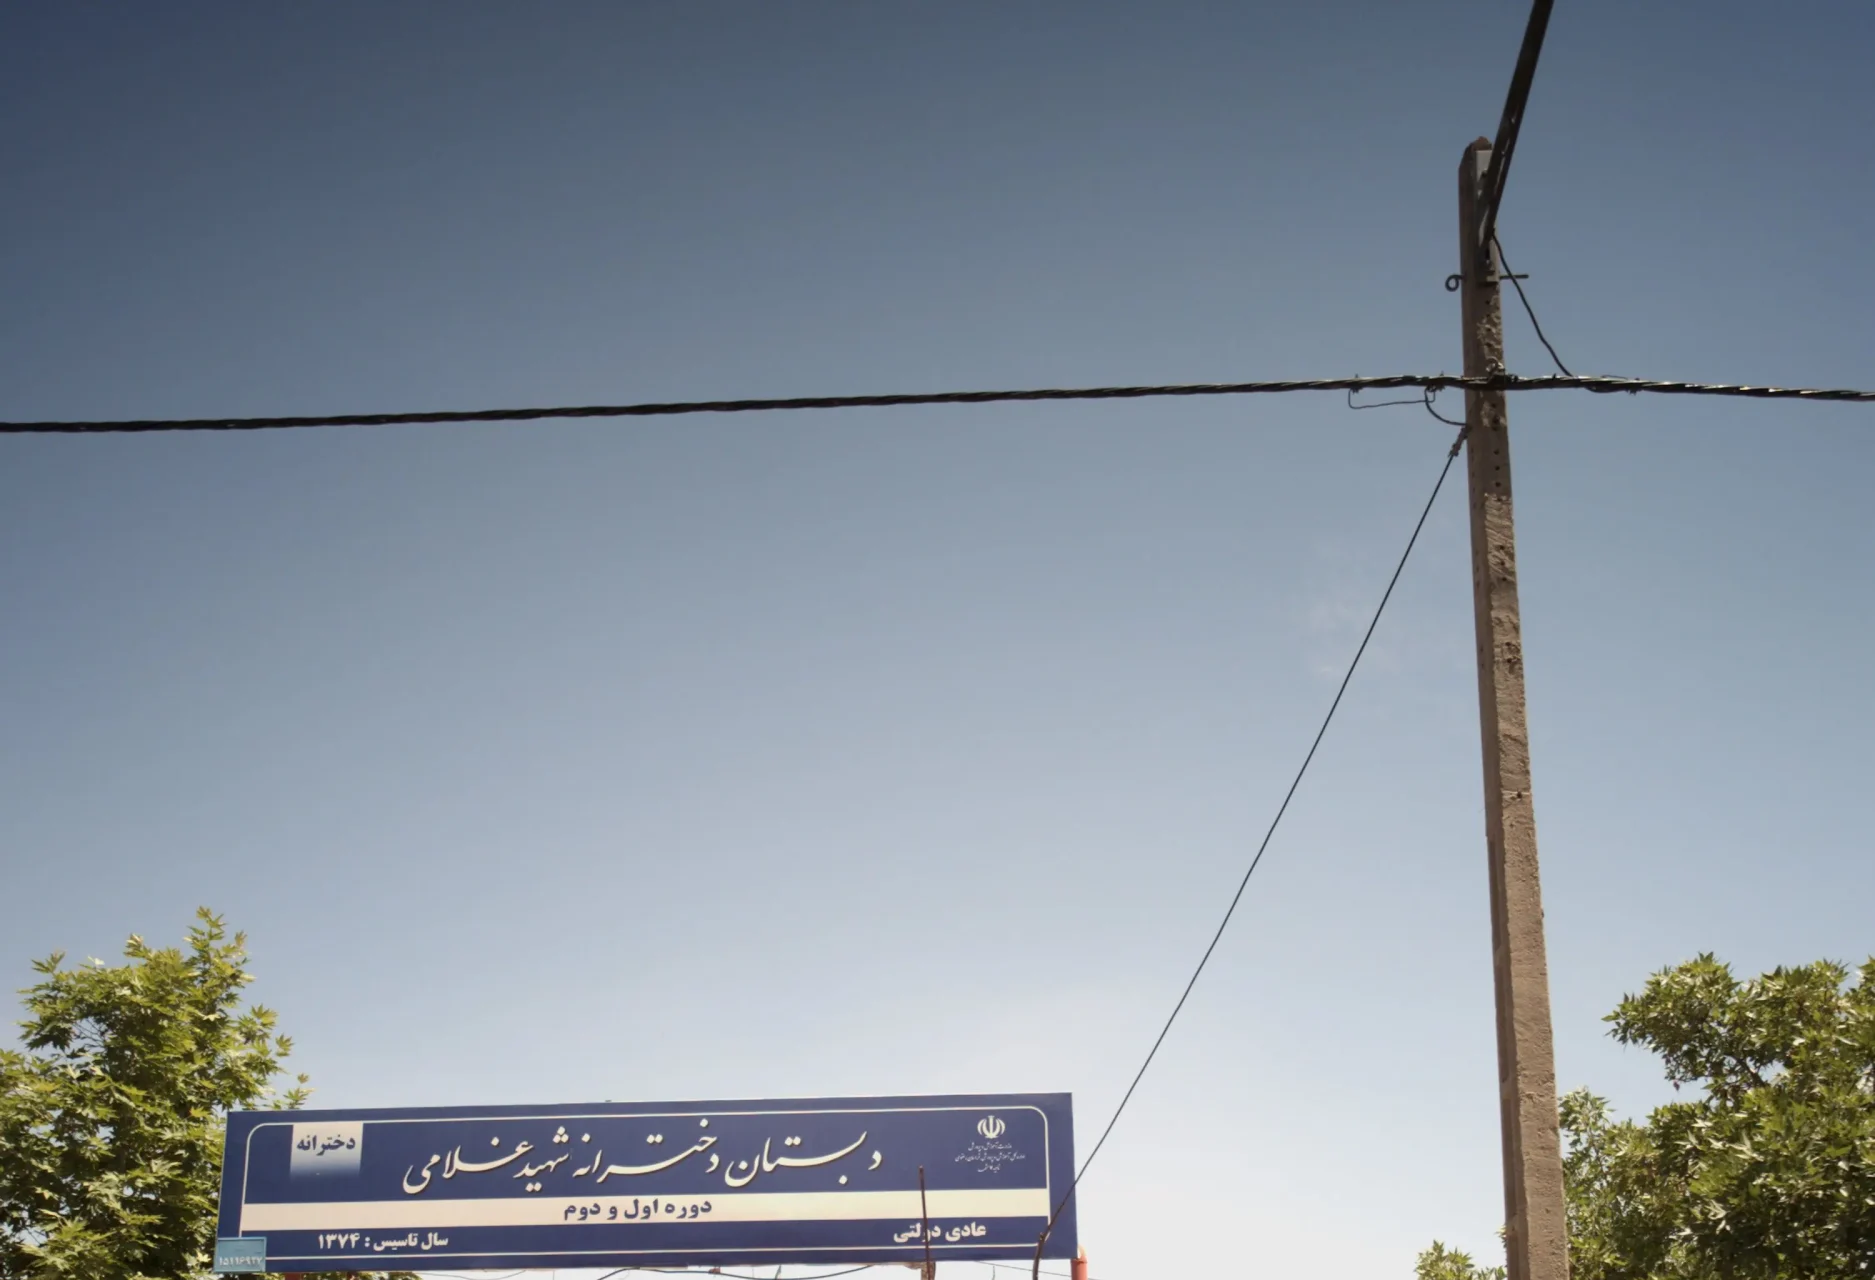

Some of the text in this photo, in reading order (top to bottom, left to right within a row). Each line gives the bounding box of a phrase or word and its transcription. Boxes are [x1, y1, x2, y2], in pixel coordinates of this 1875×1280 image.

[296, 1134, 357, 1156] دخترانه
[402, 1117, 883, 1195] دبستان دخترانه شهید غلامی
[563, 1198, 713, 1221] دوره اول و دوم
[318, 1233, 361, 1250] ۱۳۷۴
[421, 1232, 449, 1250] سال
[944, 1221, 987, 1242] عادی
[373, 1233, 419, 1252] تاسیس
